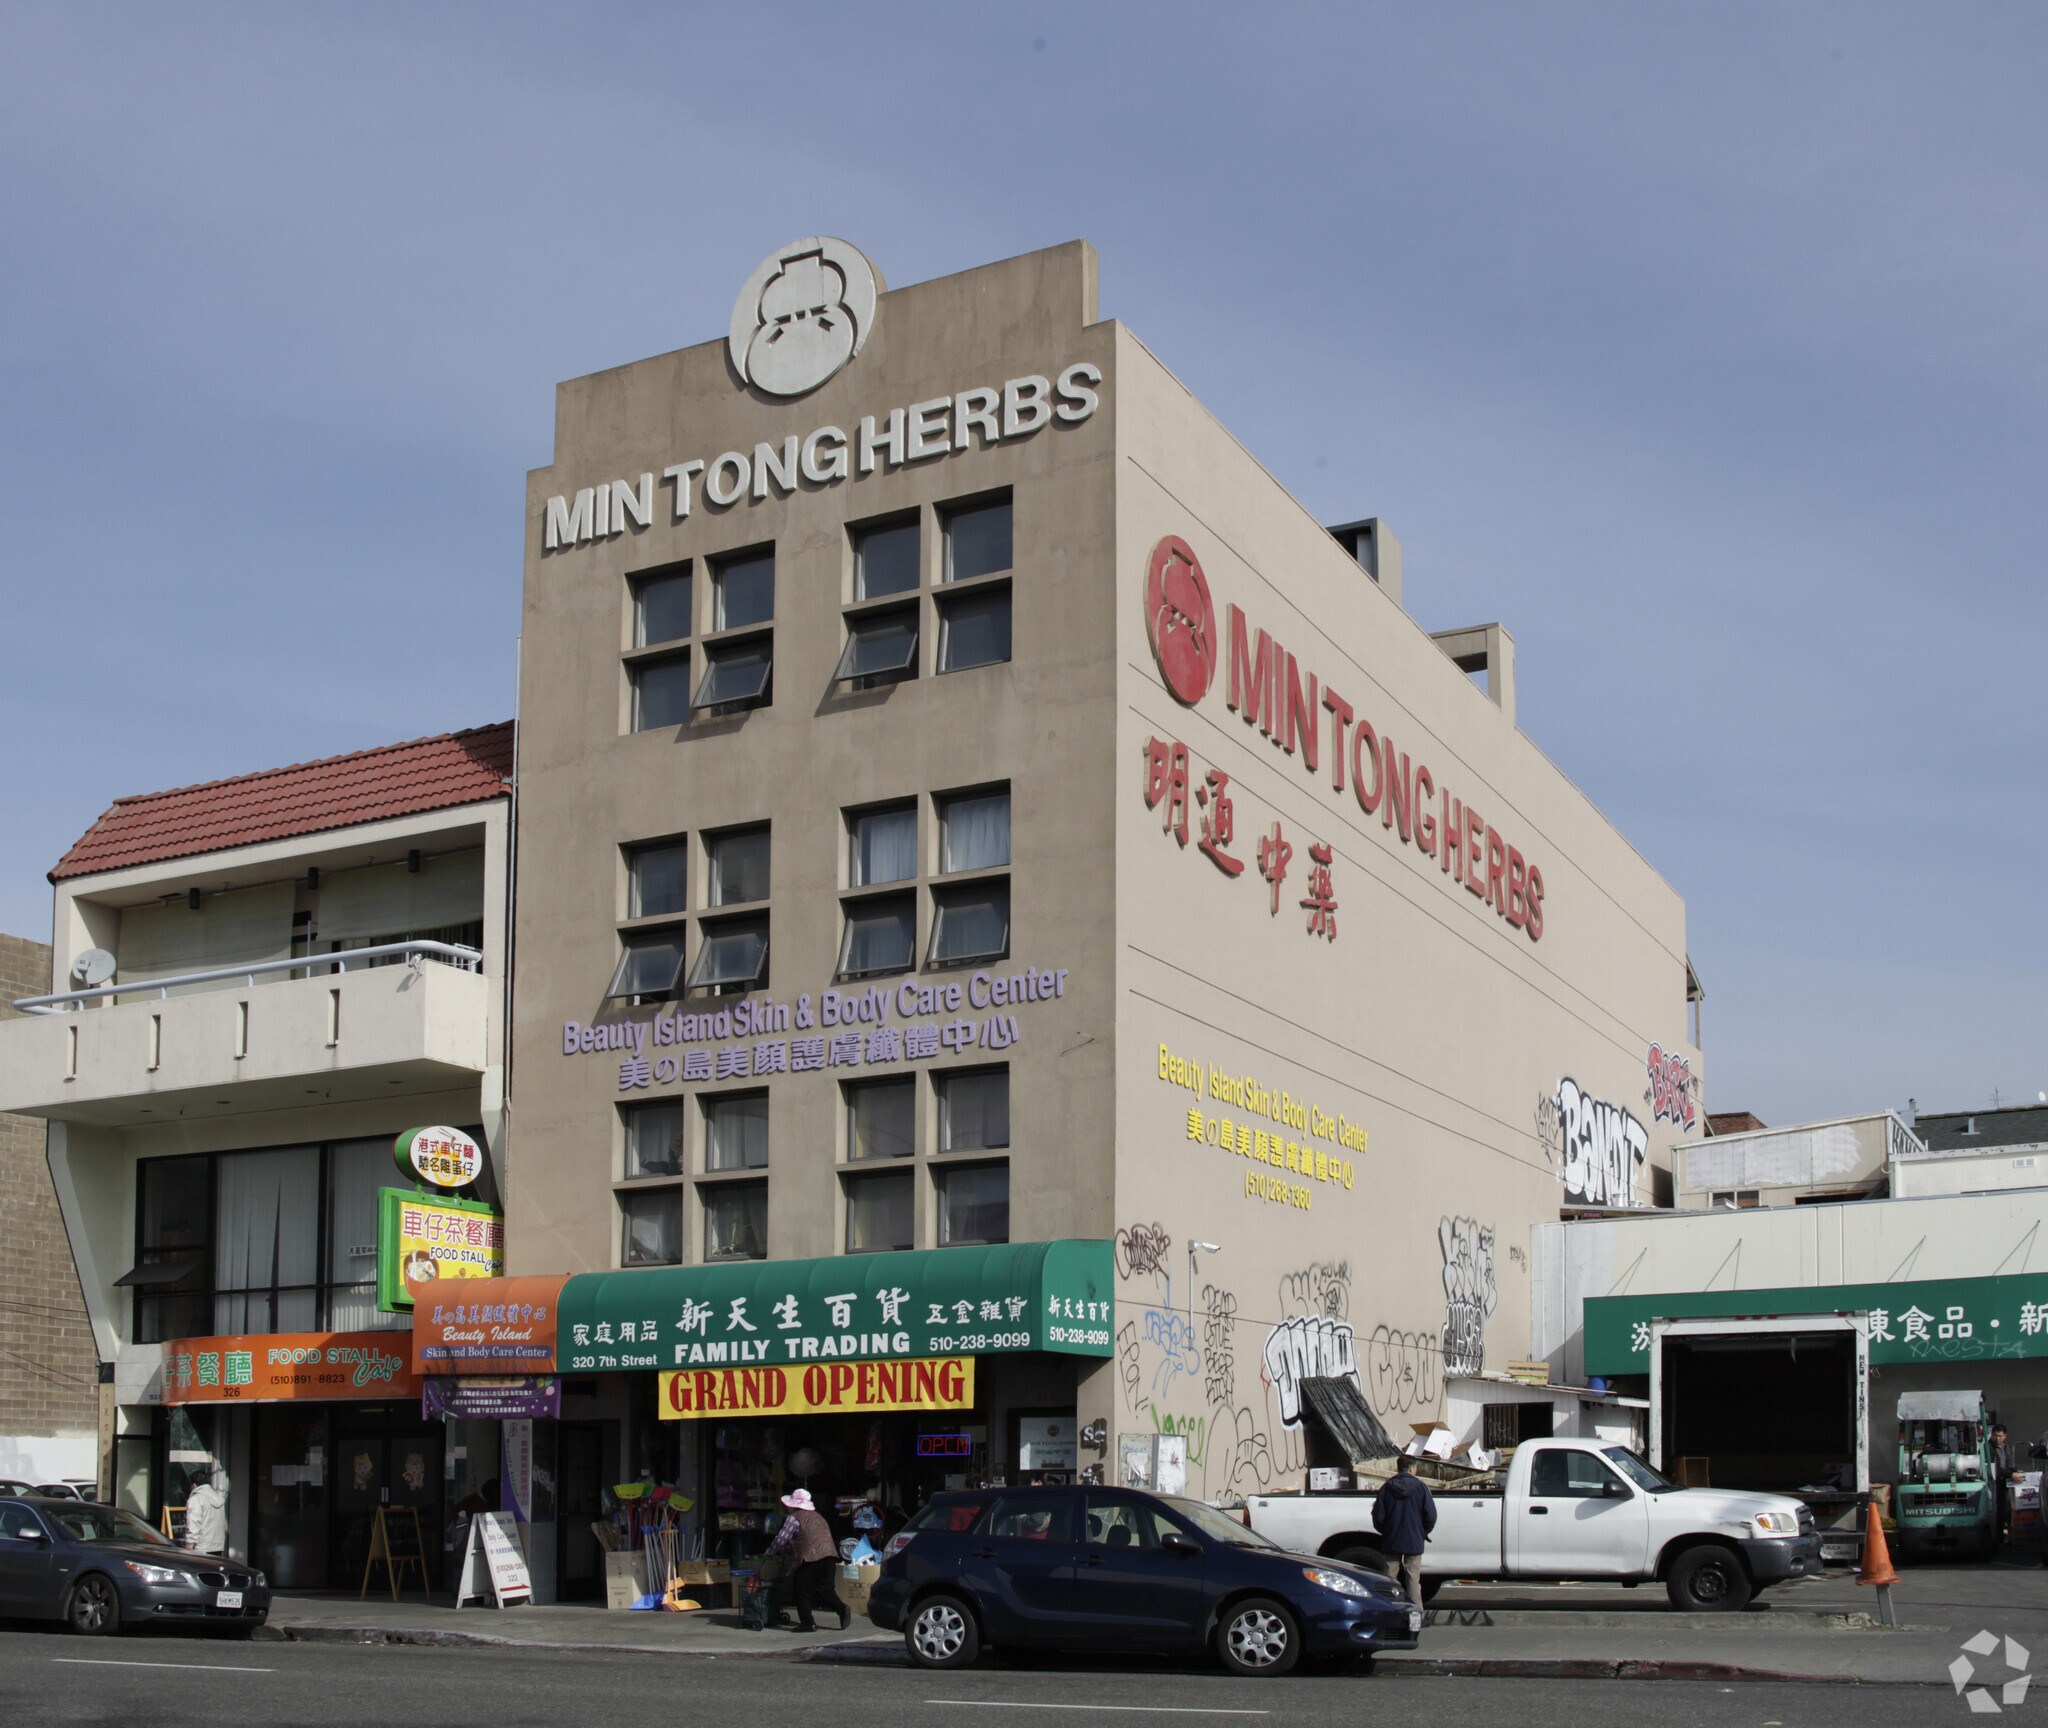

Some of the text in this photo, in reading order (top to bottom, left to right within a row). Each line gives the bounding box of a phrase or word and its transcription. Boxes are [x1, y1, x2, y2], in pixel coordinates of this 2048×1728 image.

[545, 363, 1102, 550] MIN TONG HERBS
[1226, 602, 1545, 942] MIN TONG HERBS
[563, 968, 1070, 1056] Beauty Island Skin & Body Care Center
[1158, 1042, 1369, 1153] Beauty Island Skin & Body Care Center
[430, 1247, 485, 1263] FOOD STALL
[676, 1287, 911, 1337] 新天生百貨
[926, 1296, 1028, 1324] 五金雜貨
[1048, 1295, 1110, 1323] 新天生百貨
[442, 1325, 533, 1344] Beauty Island
[573, 1320, 658, 1346] 家庭用品
[930, 1332, 1030, 1351] 510-238-9099
[1050, 1326, 1109, 1345] 510-238-9099
[268, 1348, 383, 1365] FOOD STALL
[426, 1347, 447, 1358] Skin
[468, 1346, 491, 1358] Body
[492, 1346, 514, 1357] Care
[516, 1346, 547, 1357] Center
[675, 1332, 910, 1364] FAMILY TRADING
[353, 1355, 402, 1387] Cafe
[572, 1354, 658, 1368] 320 7th Street
[223, 1387, 240, 1397] 326
[669, 1360, 966, 1412] GRAND OPENING
[920, 1436, 968, 1454] OPEN
[1905, 1506, 1976, 1517] MITSUBISHI
[507, 1574, 519, 1582] 322
